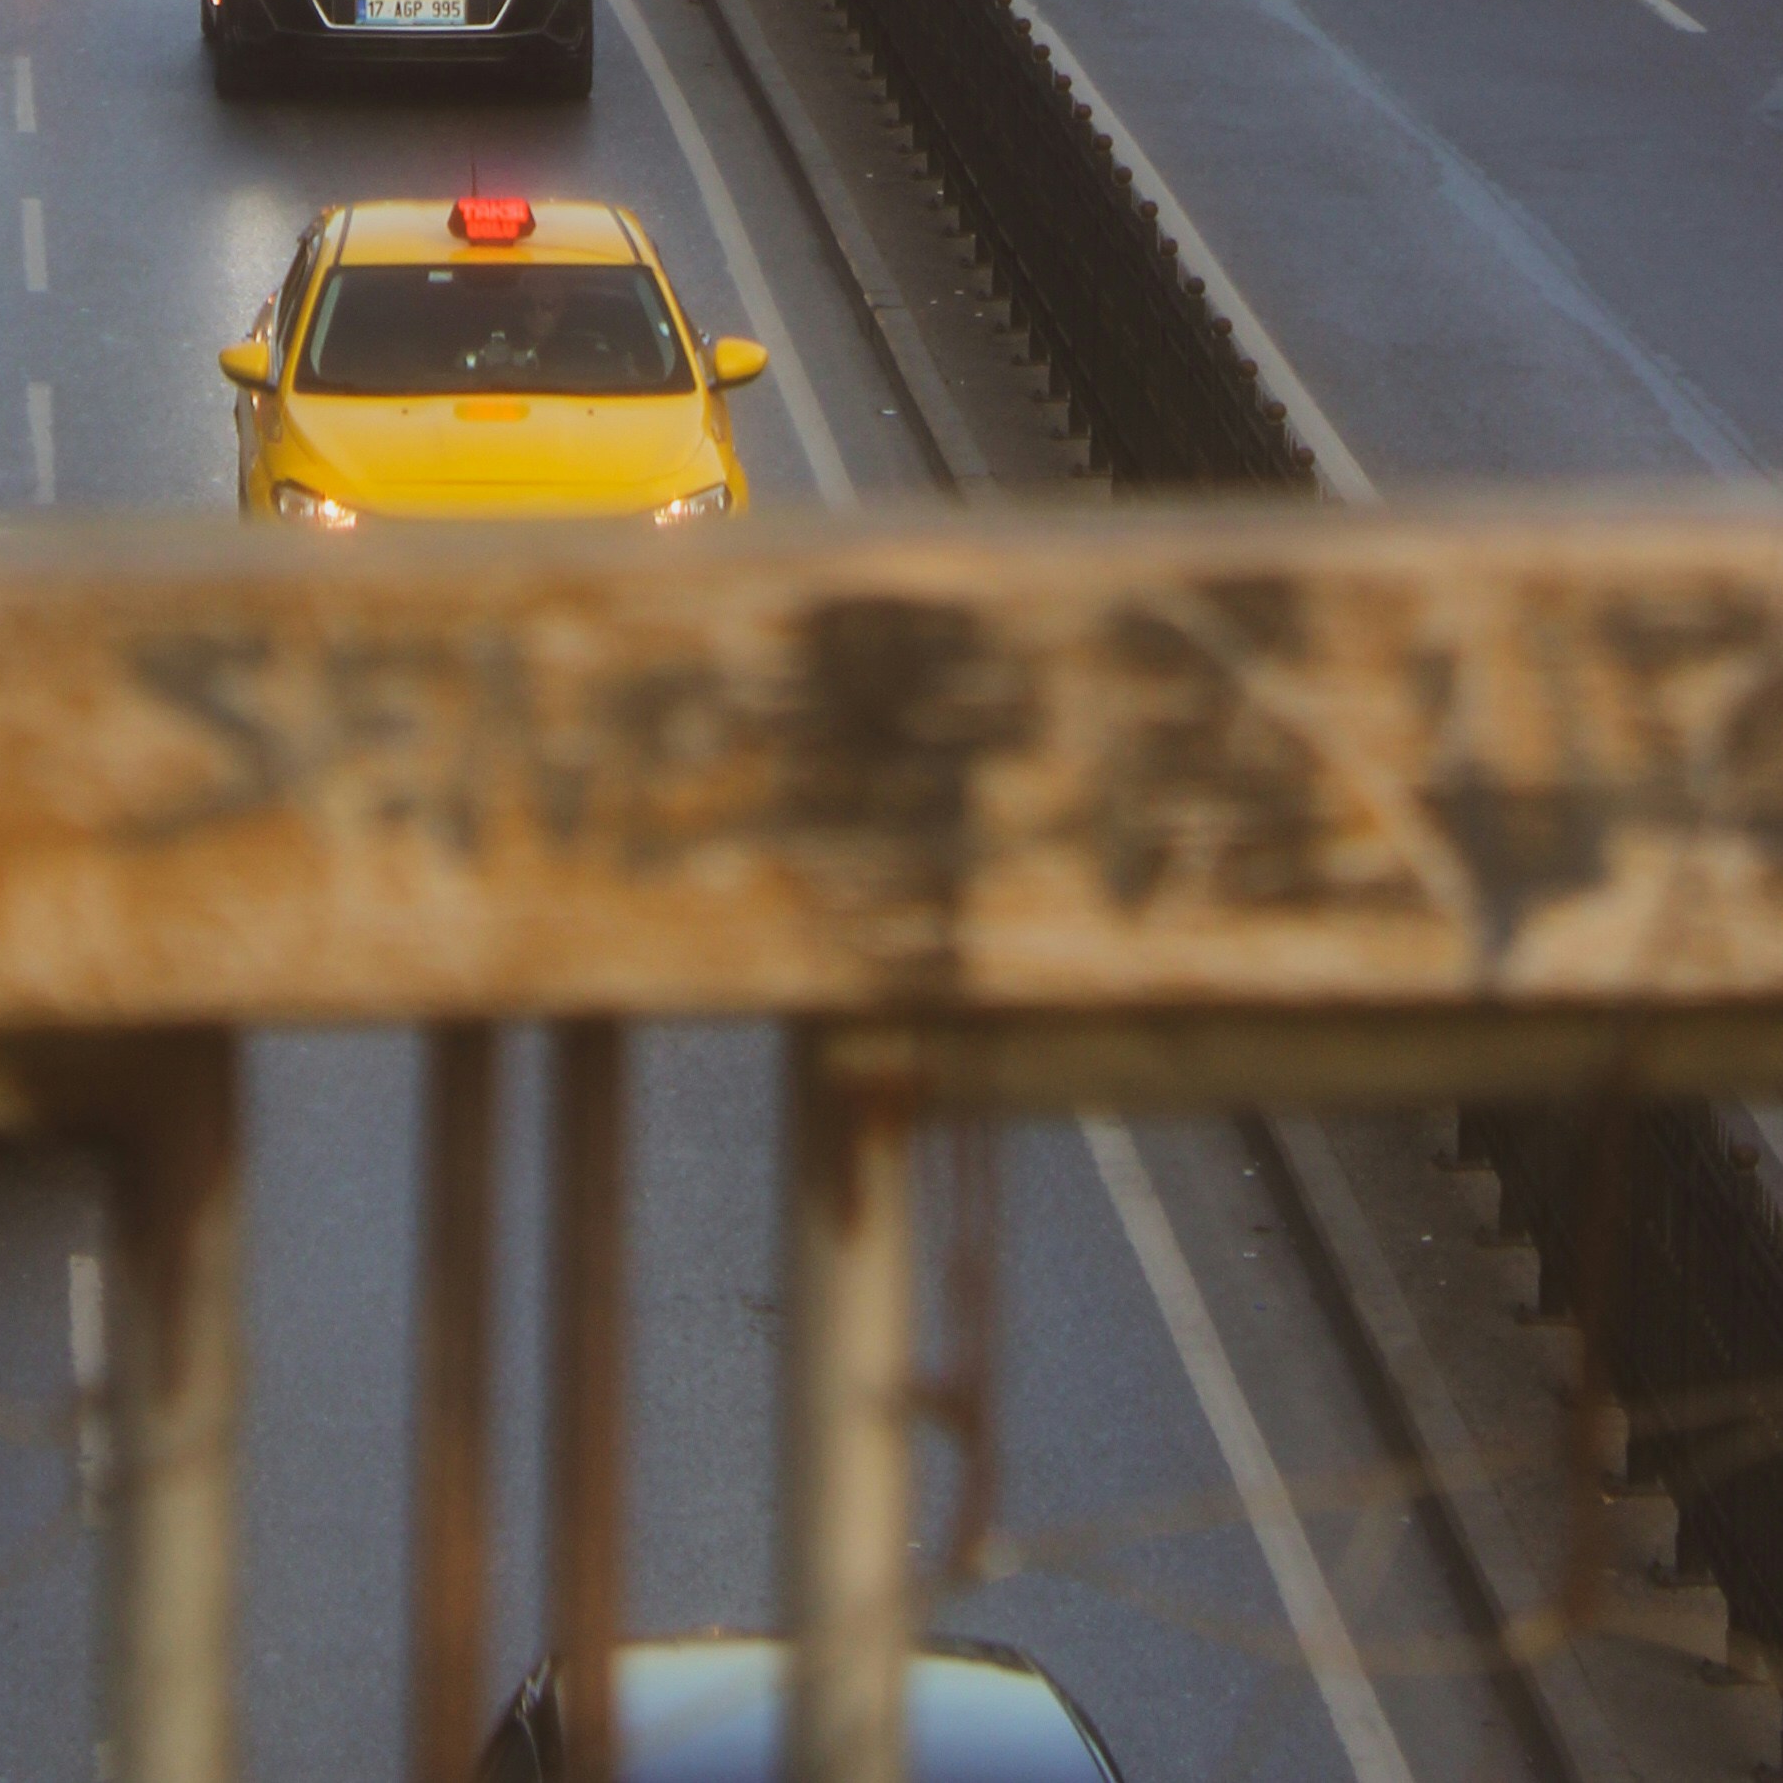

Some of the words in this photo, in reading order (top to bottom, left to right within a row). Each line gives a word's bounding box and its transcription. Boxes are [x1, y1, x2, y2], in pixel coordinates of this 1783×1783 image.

[369, 0, 384, 18] 17
[394, 0, 423, 18] AGP
[432, 0, 461, 18] 995
